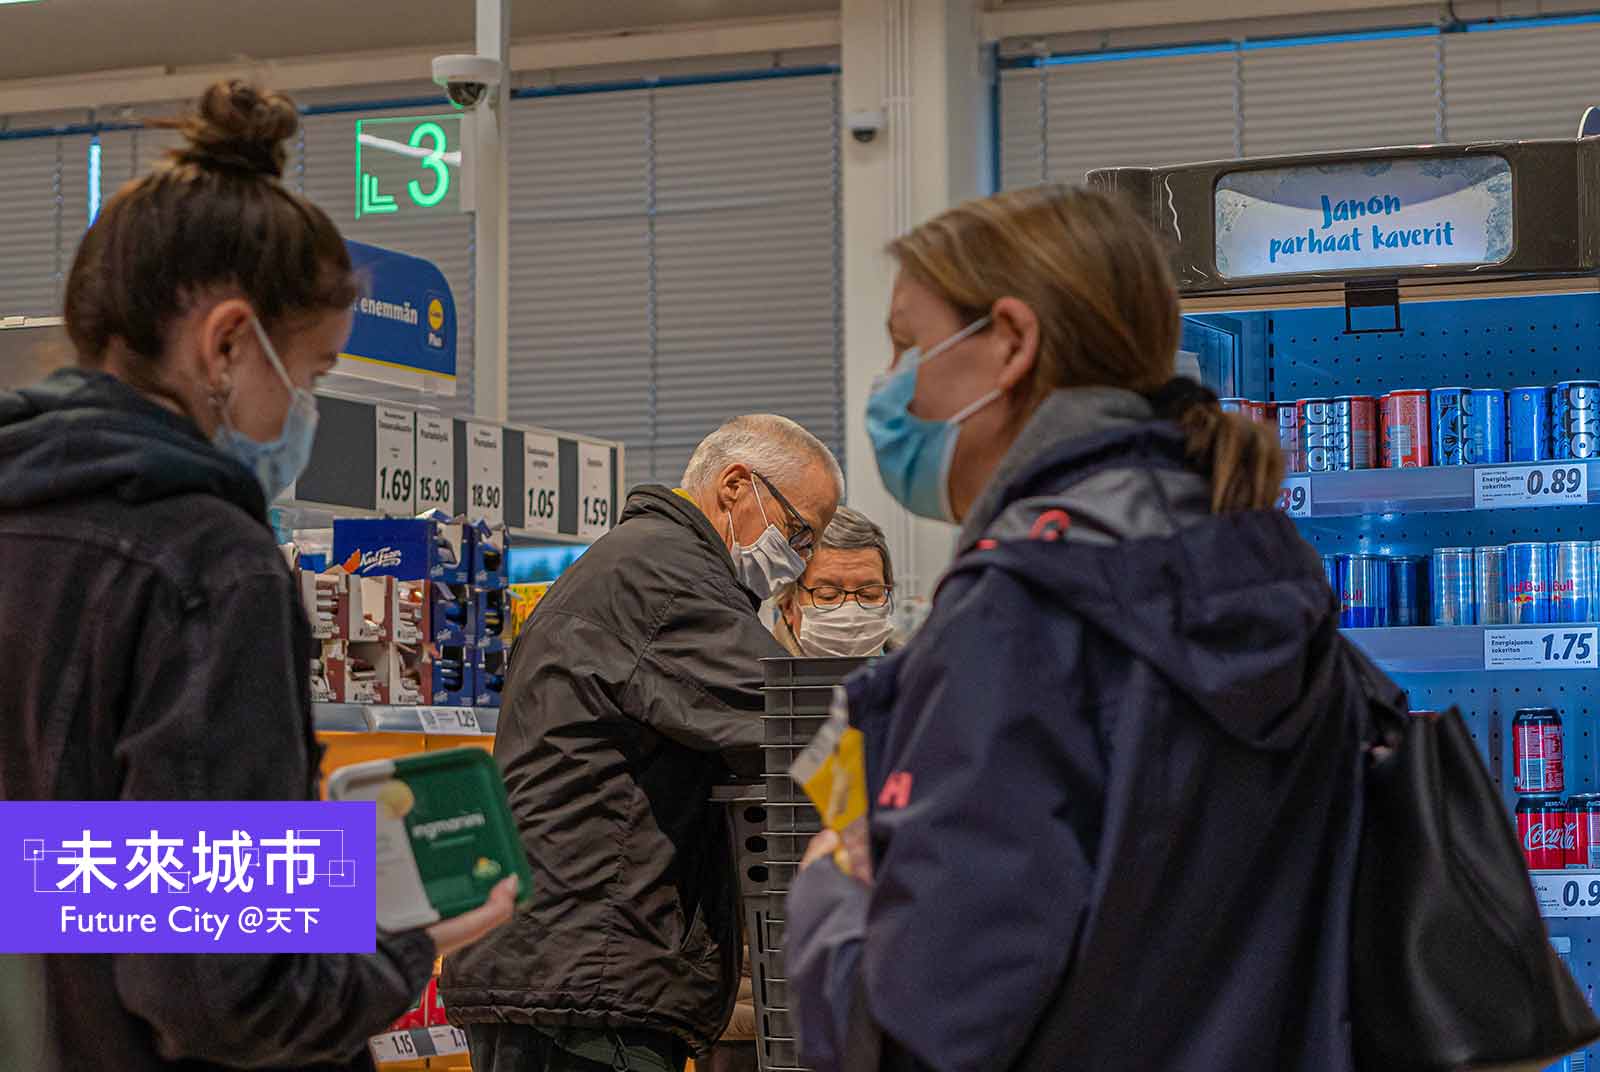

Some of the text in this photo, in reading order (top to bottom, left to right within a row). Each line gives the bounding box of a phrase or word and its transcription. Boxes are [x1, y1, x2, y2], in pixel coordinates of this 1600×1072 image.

[408, 122, 449, 207] 3
[1321, 194, 1400, 229] Janon
[1269, 221, 1455, 263] parhaat kaverit
[361, 297, 418, 326] enemmän
[380, 466, 412, 502] 1.69
[420, 477, 450, 503] 15.90
[471, 483, 500, 509] 18.90
[1527, 468, 1581, 495] 0.89
[528, 488, 555, 519] 1.05
[583, 496, 608, 526] 1.59
[1524, 580, 1545, 592] Bull
[1542, 632, 1592, 660] 1.75
[392, 1034, 414, 1055] 1.15
